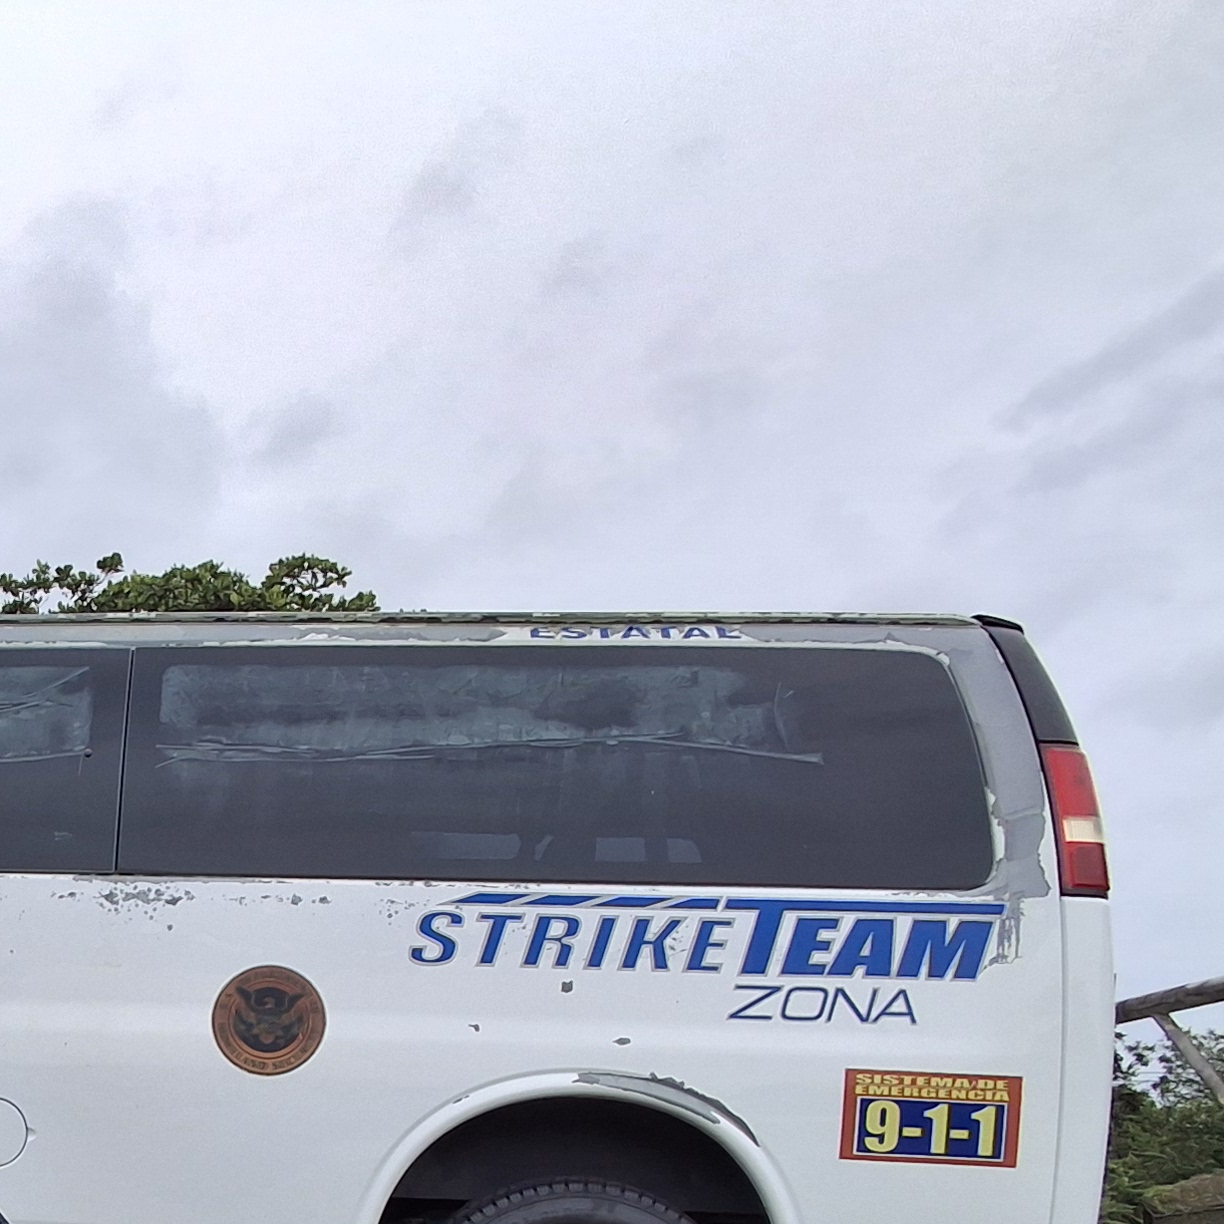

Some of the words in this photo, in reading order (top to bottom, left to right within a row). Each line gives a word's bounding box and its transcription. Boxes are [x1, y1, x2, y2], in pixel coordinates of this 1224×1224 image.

[530, 626, 743, 639] ESTATAL
[727, 983, 918, 1026] ZONA
[856, 1073, 970, 1089] SISTEMA
[976, 1080, 1009, 1091] DE
[855, 1085, 1010, 1102] EMERGENCIA
[864, 1100, 997, 1157] 9-1-1
